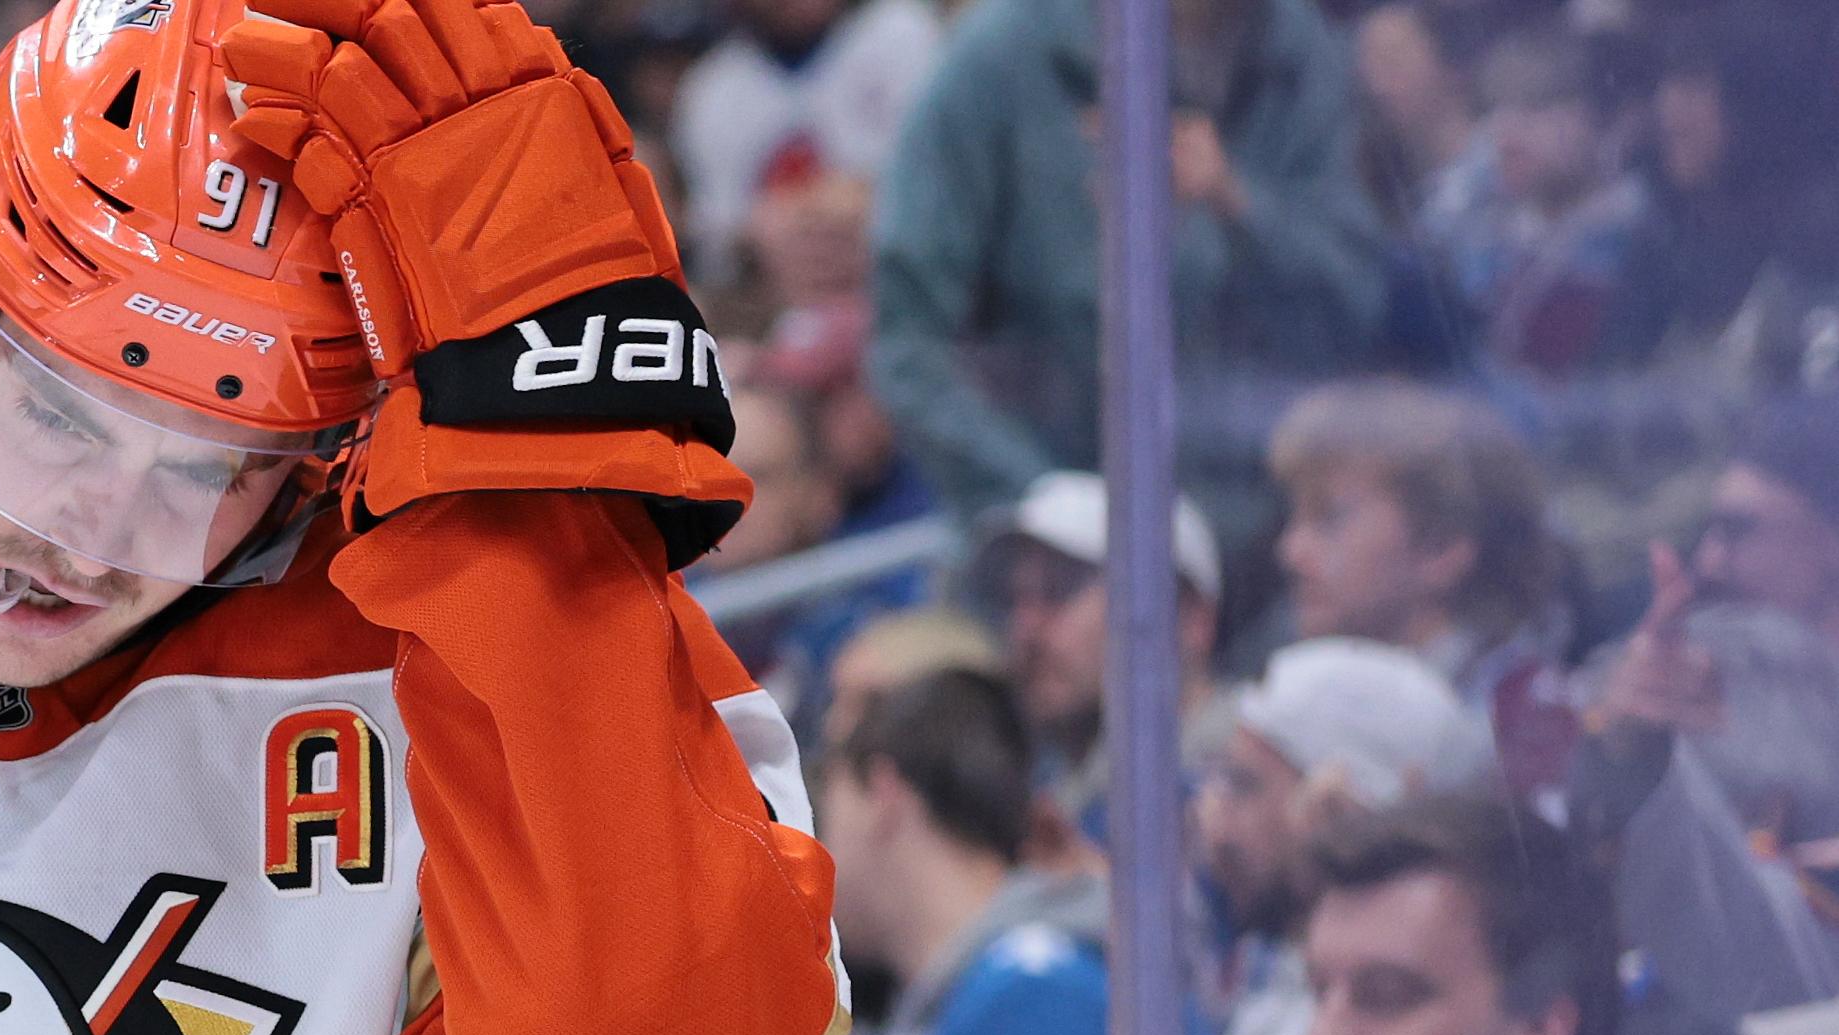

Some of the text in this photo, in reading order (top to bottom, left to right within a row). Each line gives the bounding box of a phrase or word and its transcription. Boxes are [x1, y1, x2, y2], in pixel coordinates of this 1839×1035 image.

[197, 159, 280, 248] 91
[124, 291, 276, 355] BAUER
[340, 250, 385, 361] CARLSSON
[264, 708, 386, 891] A
